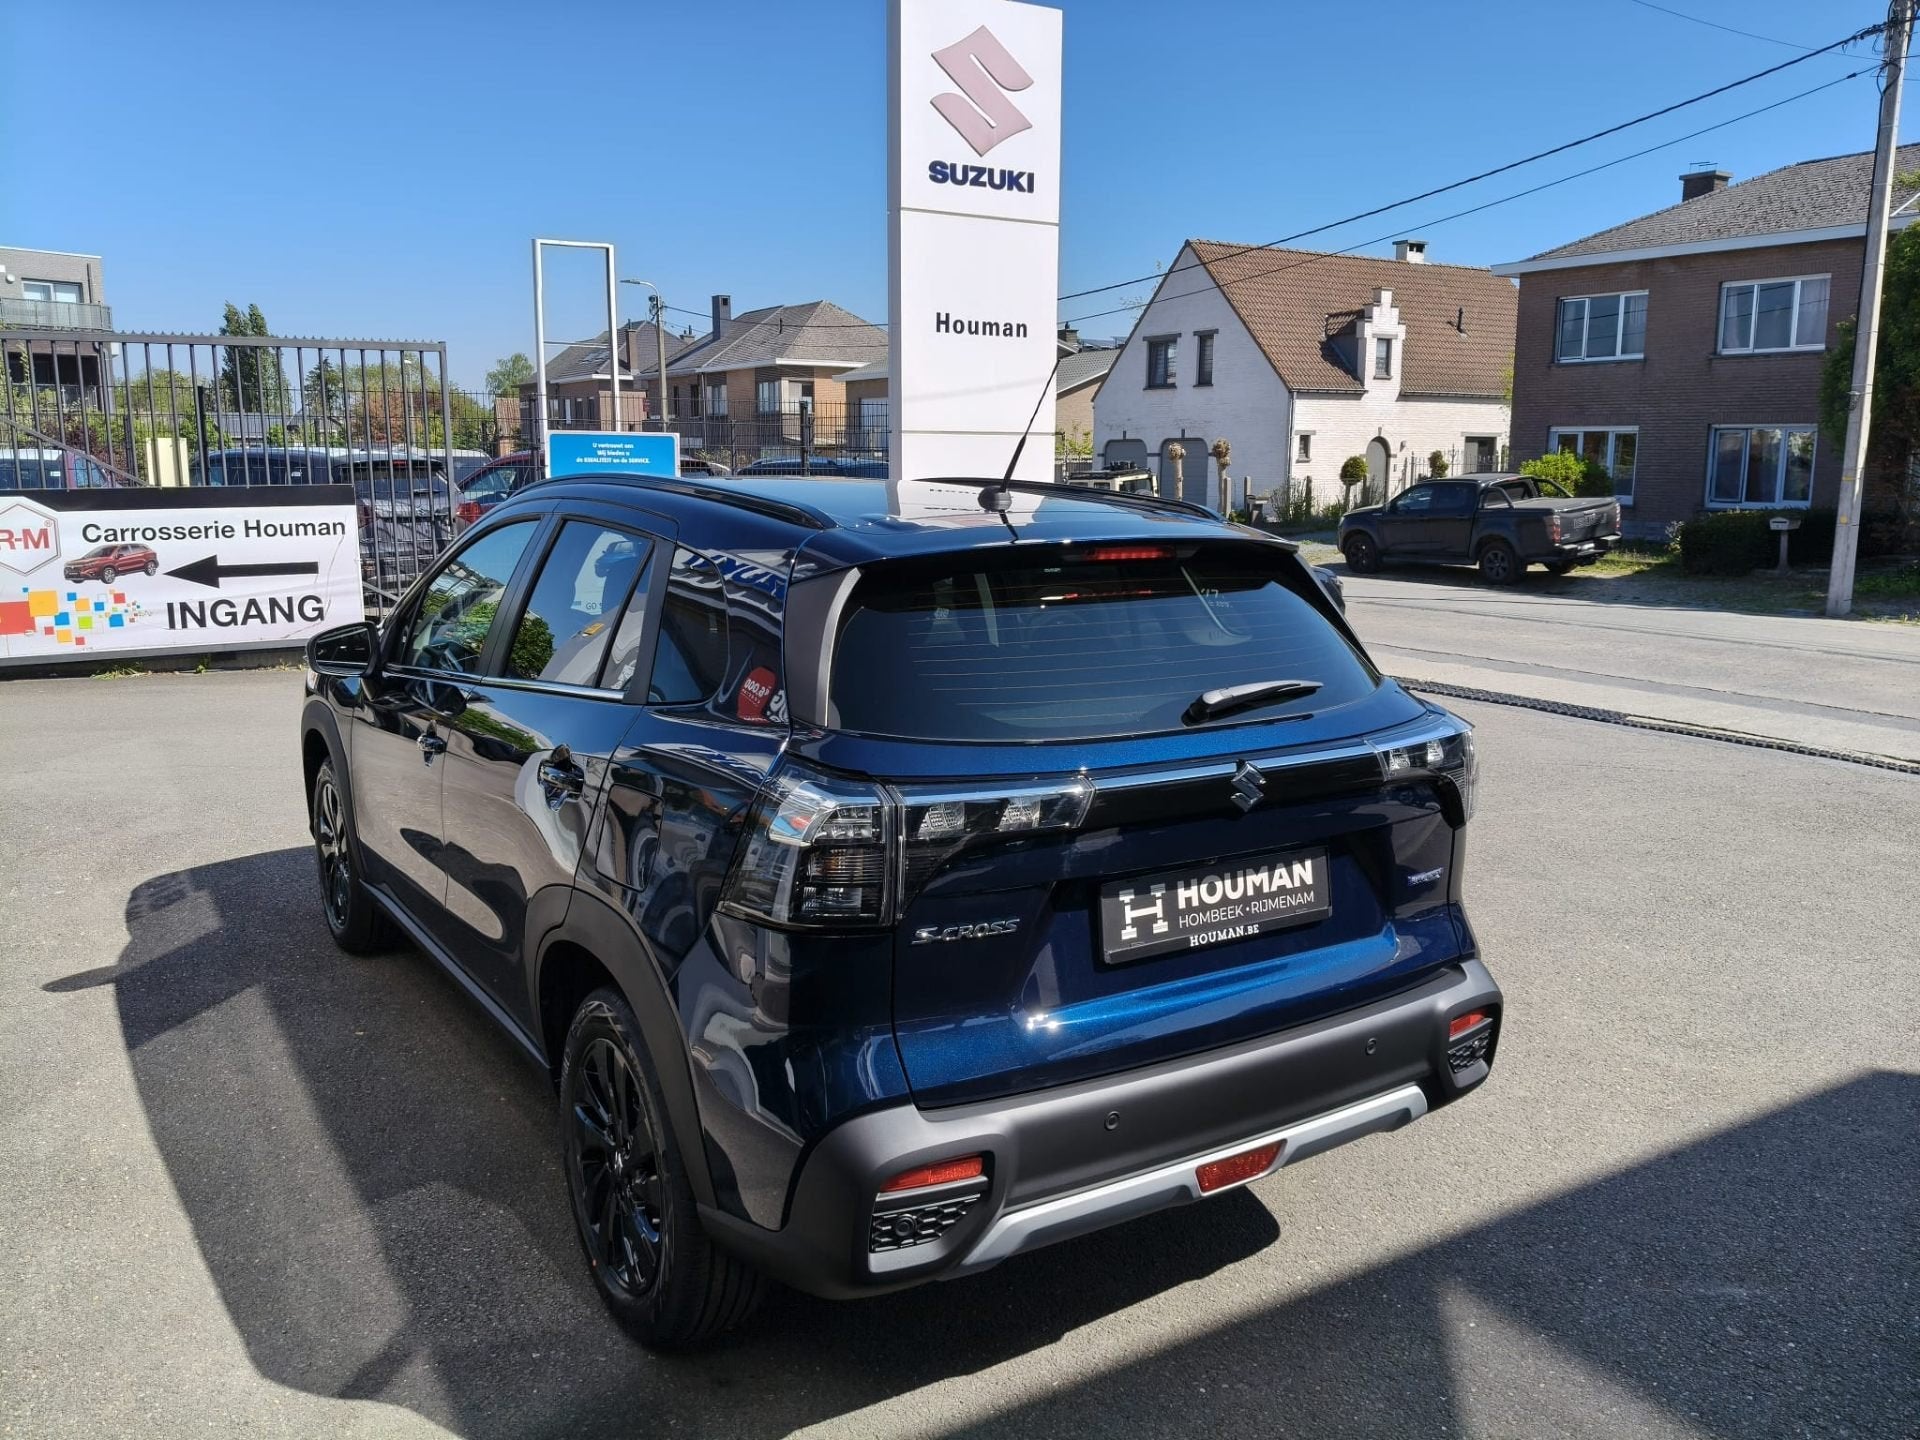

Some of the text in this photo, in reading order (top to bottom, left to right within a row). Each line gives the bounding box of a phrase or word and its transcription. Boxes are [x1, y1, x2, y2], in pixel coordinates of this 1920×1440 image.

[928, 160, 1034, 194] SUZUKI
[935, 311, 1028, 338] Houman
[0, 528, 50, 550] R-M
[82, 519, 346, 543] Carrosserie Houman
[166, 595, 325, 630] INGANG
[1177, 858, 1314, 909] HOUMAN
[1190, 924, 1260, 947] HOUMAN.BE
